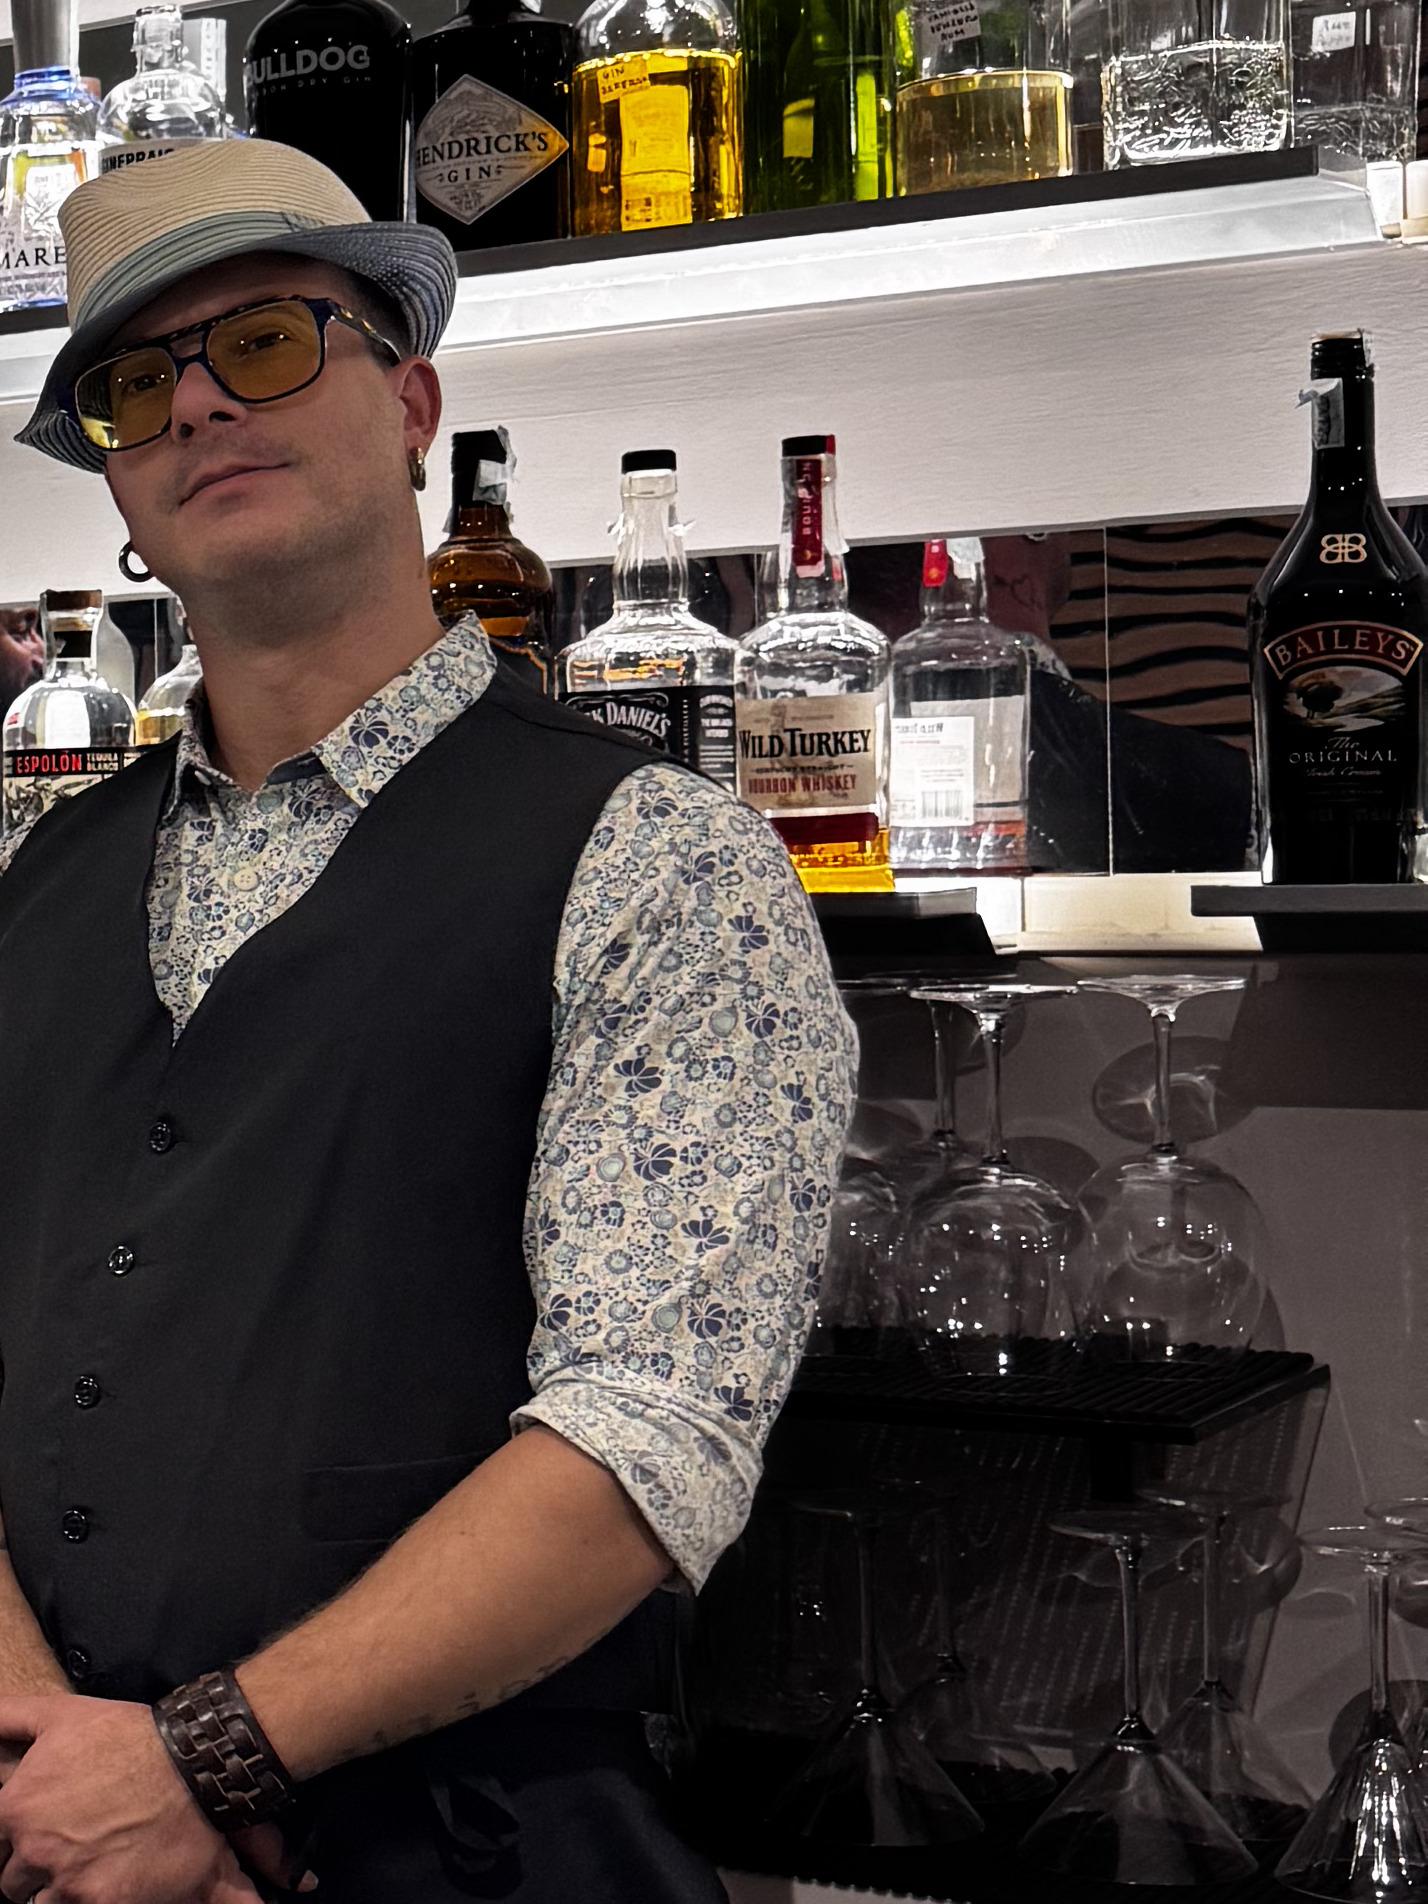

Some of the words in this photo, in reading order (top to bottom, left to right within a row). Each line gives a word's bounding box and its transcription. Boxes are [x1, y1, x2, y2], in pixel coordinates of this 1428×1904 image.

[244, 45, 370, 87] BULLDOG
[416, 132, 548, 167] HENDRICK'S
[448, 166, 491, 183] GIN
[1275, 629, 1411, 666] BAILEYS
[607, 702, 671, 738] DANIEL'S
[739, 729, 782, 759] WILD
[784, 727, 871, 758] TURKEY
[1325, 736, 1360, 749] The
[17, 750, 82, 774] ESPOLÓN
[1289, 750, 1397, 764] ORIGINAL
[801, 774, 856, 794] WHISKEY
